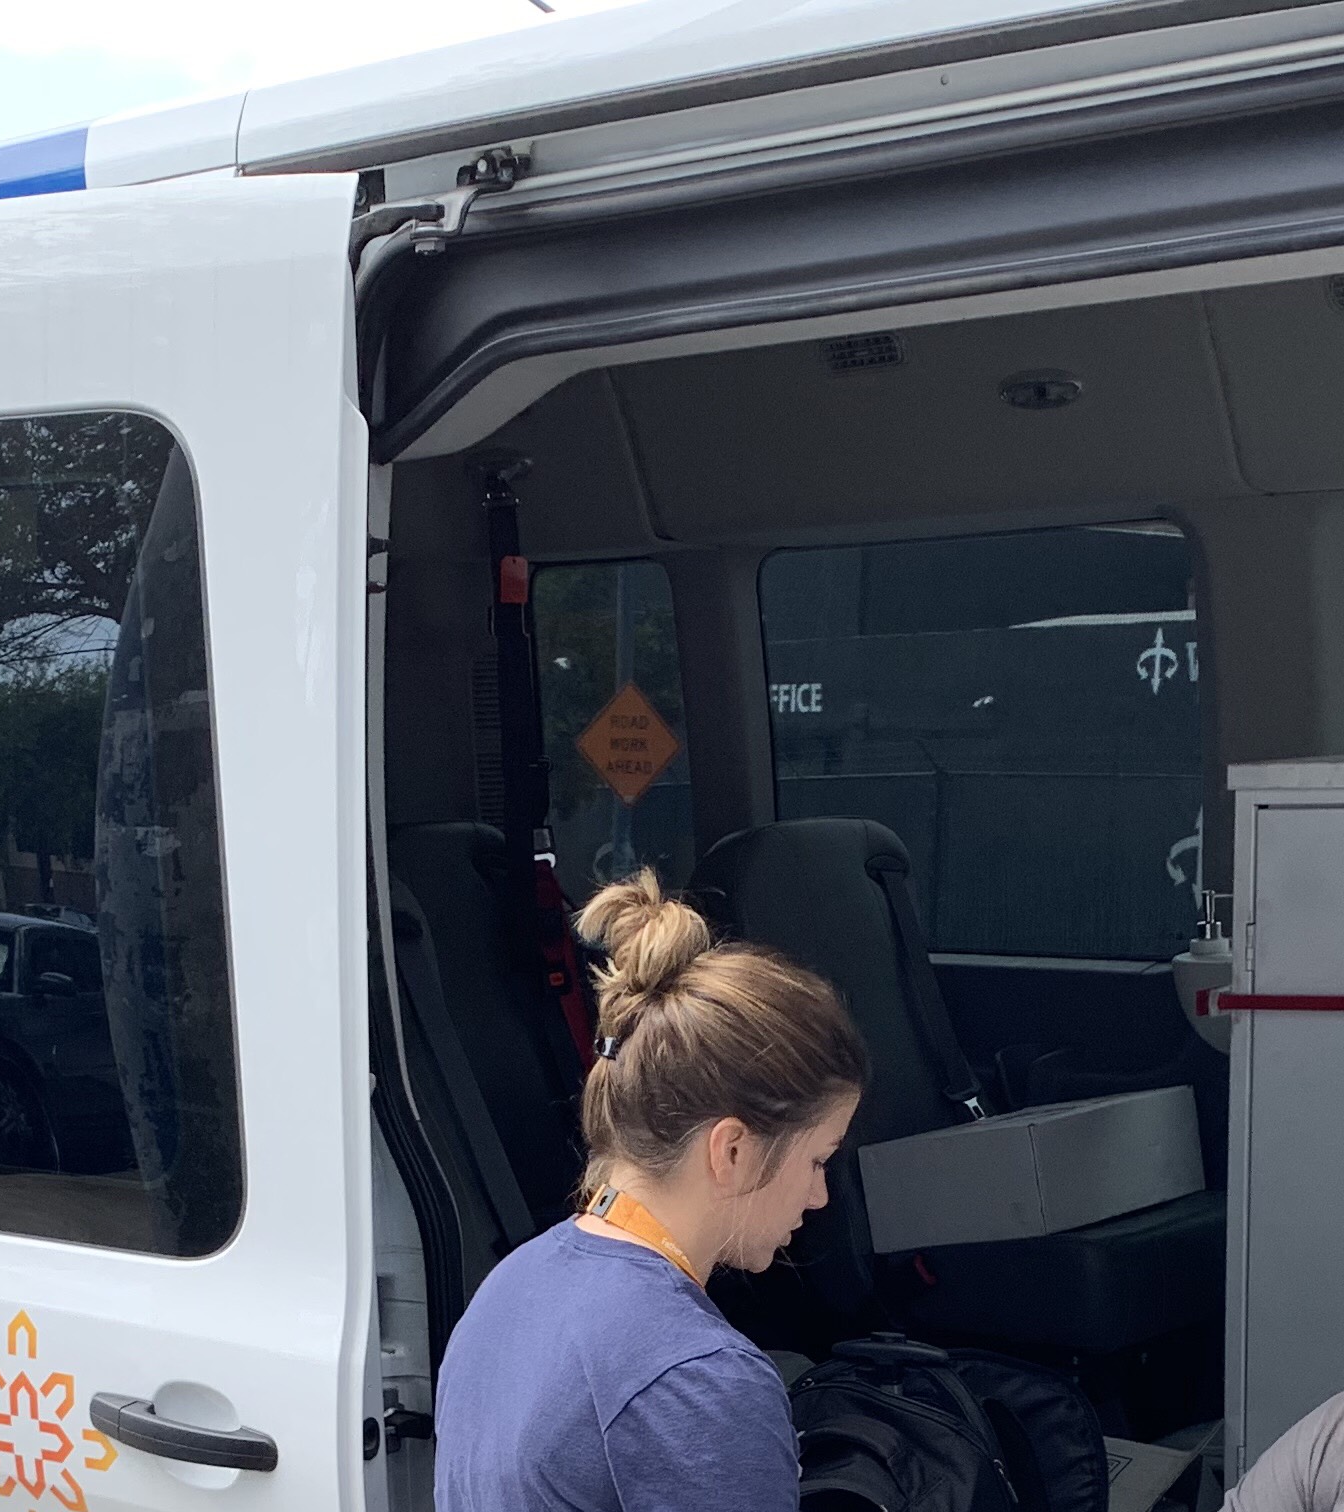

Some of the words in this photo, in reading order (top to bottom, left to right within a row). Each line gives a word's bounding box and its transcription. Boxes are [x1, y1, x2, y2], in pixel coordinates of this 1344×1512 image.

[609, 714, 650, 730] ROAD
[609, 737, 649, 752] WORK
[606, 759, 655, 775] AHEAD
